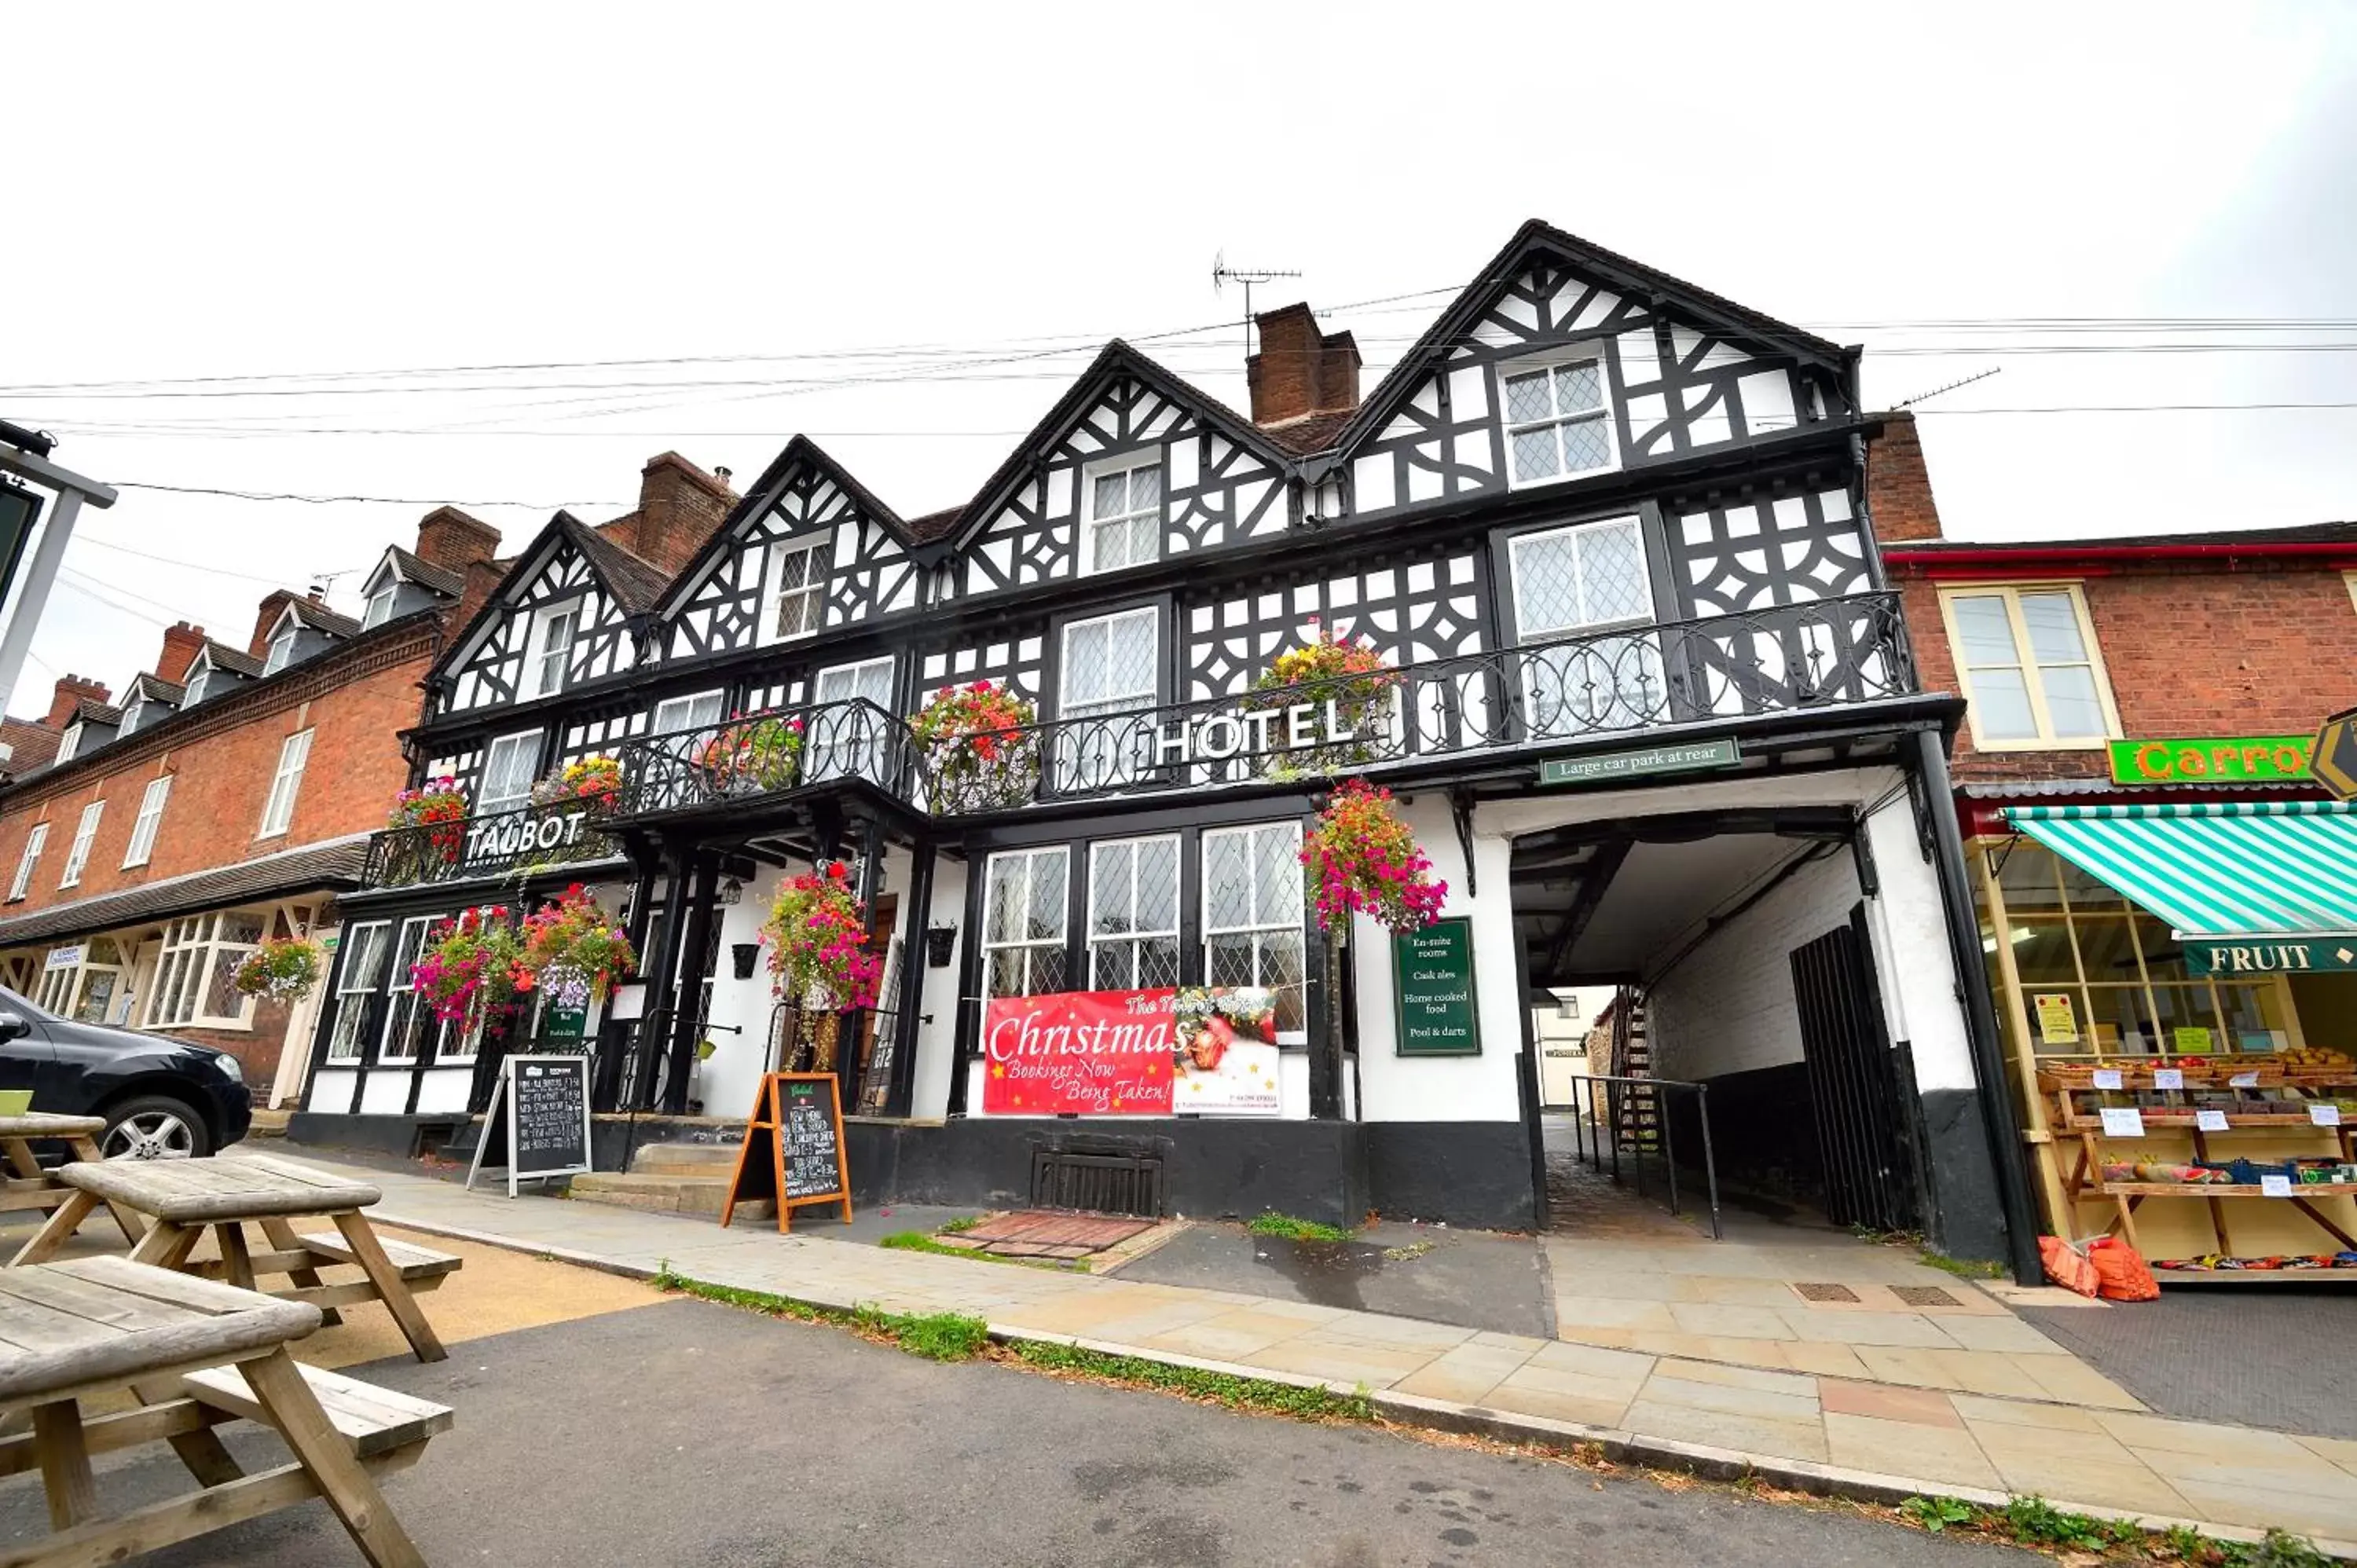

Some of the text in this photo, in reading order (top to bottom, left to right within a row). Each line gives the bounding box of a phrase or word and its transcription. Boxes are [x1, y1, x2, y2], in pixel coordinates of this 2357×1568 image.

[1156, 699, 1354, 766] HOTEL
[1559, 747, 1717, 777] Large car park at rear
[467, 811, 587, 860] TALBOT
[1413, 936, 1451, 947] En-suite
[1418, 950, 1448, 958] rooms
[2210, 944, 2311, 972] FRUIT
[1413, 969, 1456, 980] Cask ales
[1125, 995, 1158, 1015] The
[1404, 991, 1468, 1004] Home cooked
[1426, 1004, 1446, 1014] food
[989, 1010, 1192, 1062] Christmas
[1410, 1027, 1467, 1038] Pool & darts
[1006, 1058, 1116, 1090] Bookings Now
[1066, 1080, 1172, 1111] Being Taken!
